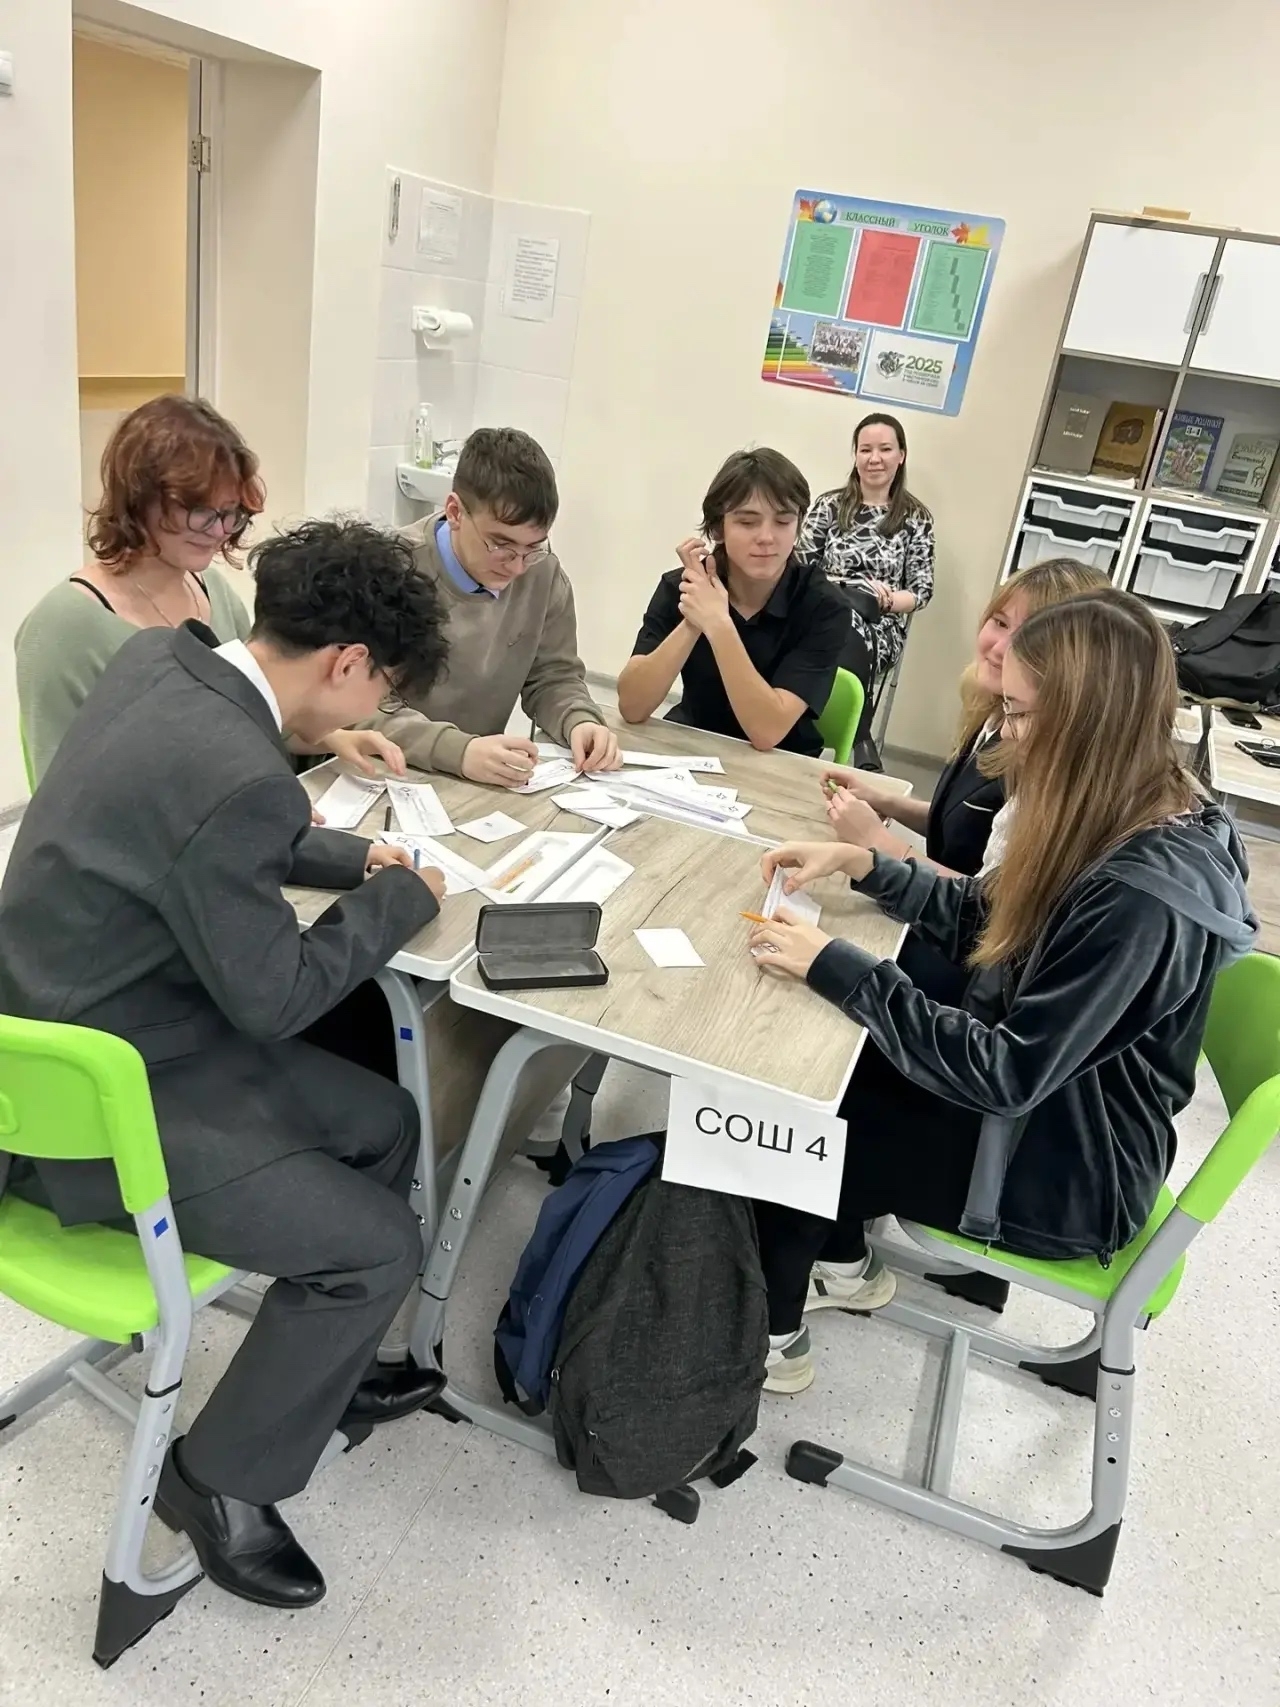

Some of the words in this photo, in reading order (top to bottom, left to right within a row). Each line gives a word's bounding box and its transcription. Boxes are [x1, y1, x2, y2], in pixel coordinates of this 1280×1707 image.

[846, 212, 895, 227] КЛАССНЫЙ
[914, 222, 950, 236] УГОЛОК
[905, 355, 943, 374] 2025
[695, 1106, 793, 1154] СОШ
[805, 1135, 828, 1161] 4
